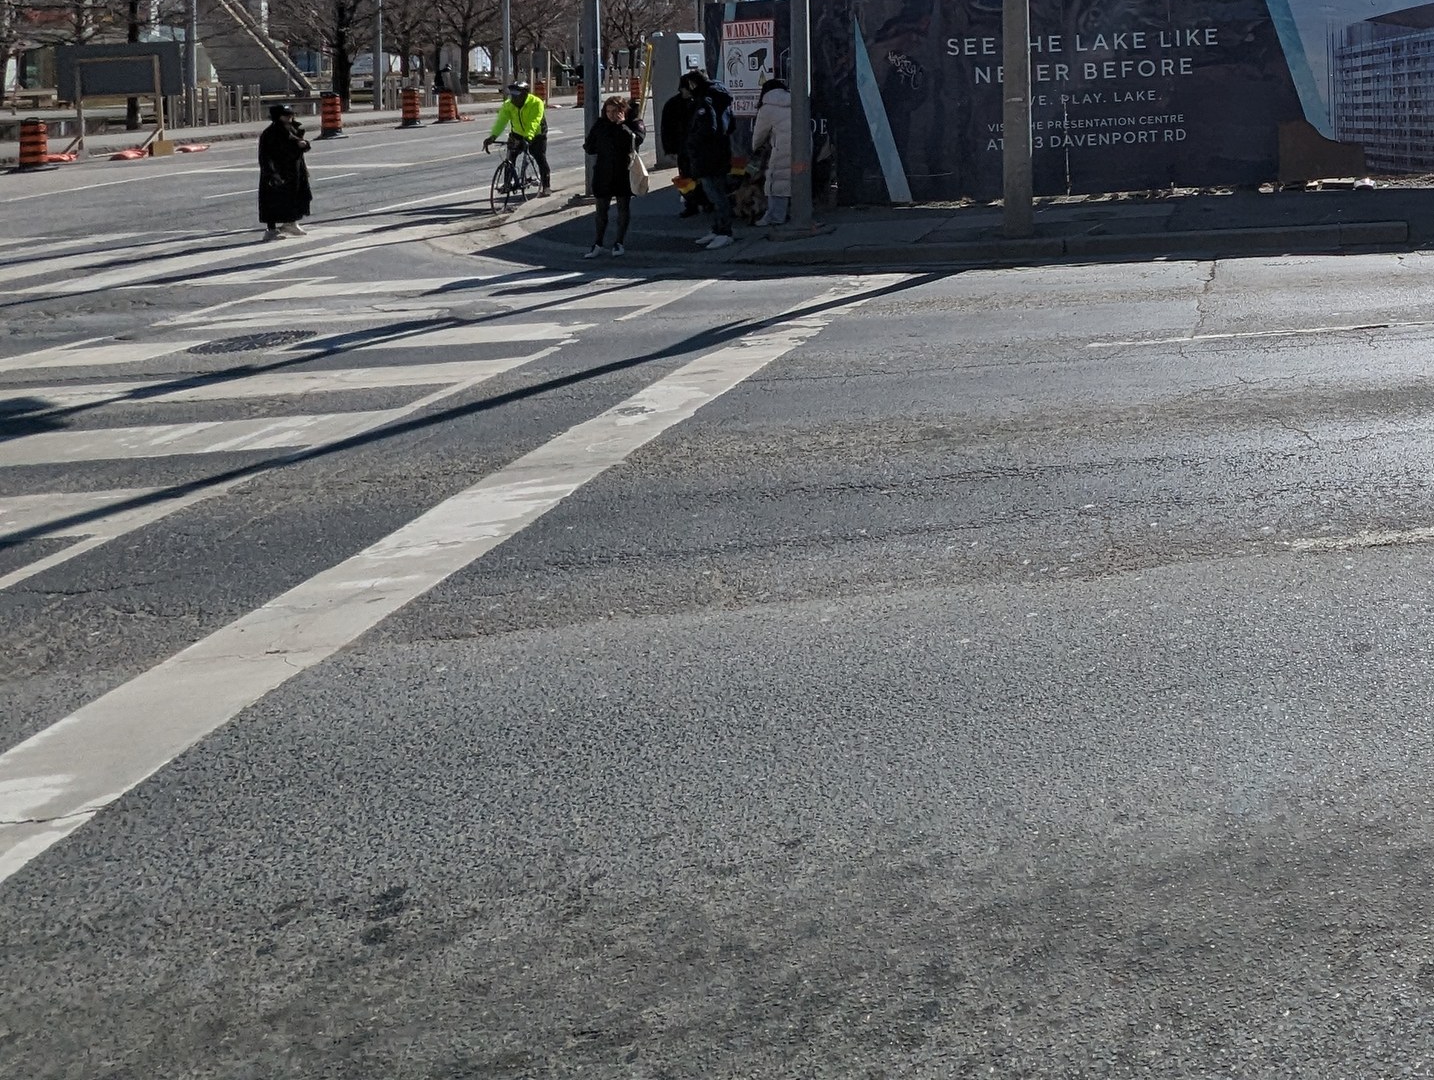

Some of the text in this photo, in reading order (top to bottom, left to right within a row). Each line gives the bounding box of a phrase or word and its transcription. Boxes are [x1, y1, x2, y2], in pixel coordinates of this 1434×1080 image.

[726, 21, 771, 38] WARNING!
[947, 28, 1219, 56] SEE HE LAKE LIKE
[975, 57, 1193, 85] NEER BEFORE
[1061, 92, 1107, 106] PLAY.
[1113, 90, 1163, 103] LAKE.
[987, 113, 1185, 133] VIS HE PRESENTATION CENTRE
[1050, 130, 1158, 148] DAVENPORT
[1164, 128, 1187, 142] RD
